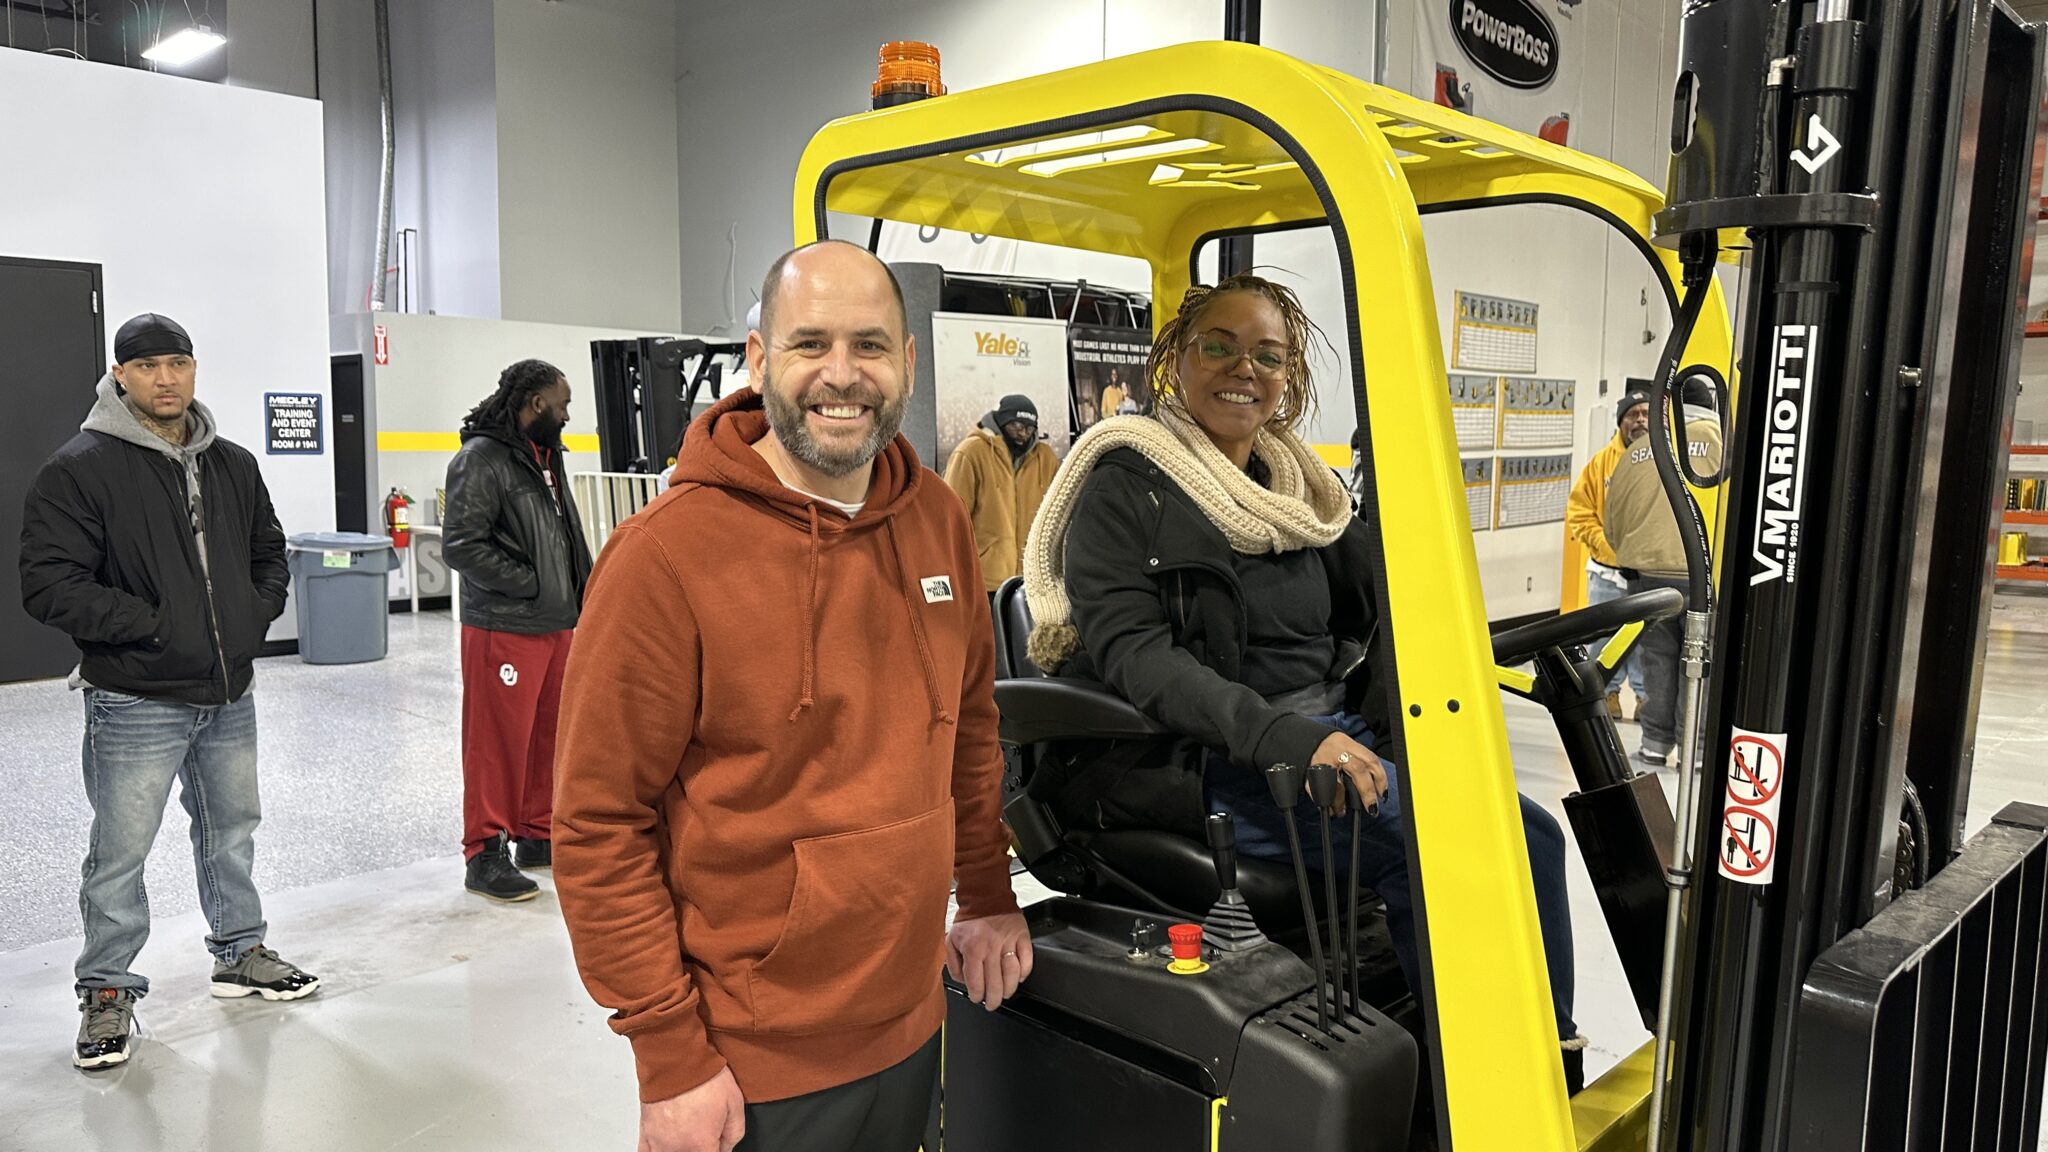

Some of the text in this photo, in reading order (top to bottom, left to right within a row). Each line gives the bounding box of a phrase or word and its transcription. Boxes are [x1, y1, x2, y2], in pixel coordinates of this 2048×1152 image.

[975, 331, 1018, 356] Yale
[1102, 353, 1127, 364] ATHLETES
[1127, 354, 1140, 365] PLAY
[269, 396, 318, 405] MEDLEY
[274, 409, 313, 418] TRAINING
[272, 418, 317, 428] AND EVENT
[278, 428, 312, 438] CENTER
[272, 440, 294, 449] ROOM
[1631, 447, 1655, 464] SEA
[1750, 324, 1806, 586] V.MARIOTTI
[1786, 522, 1799, 583] SINCE 1920
[500, 663, 518, 686] OU
